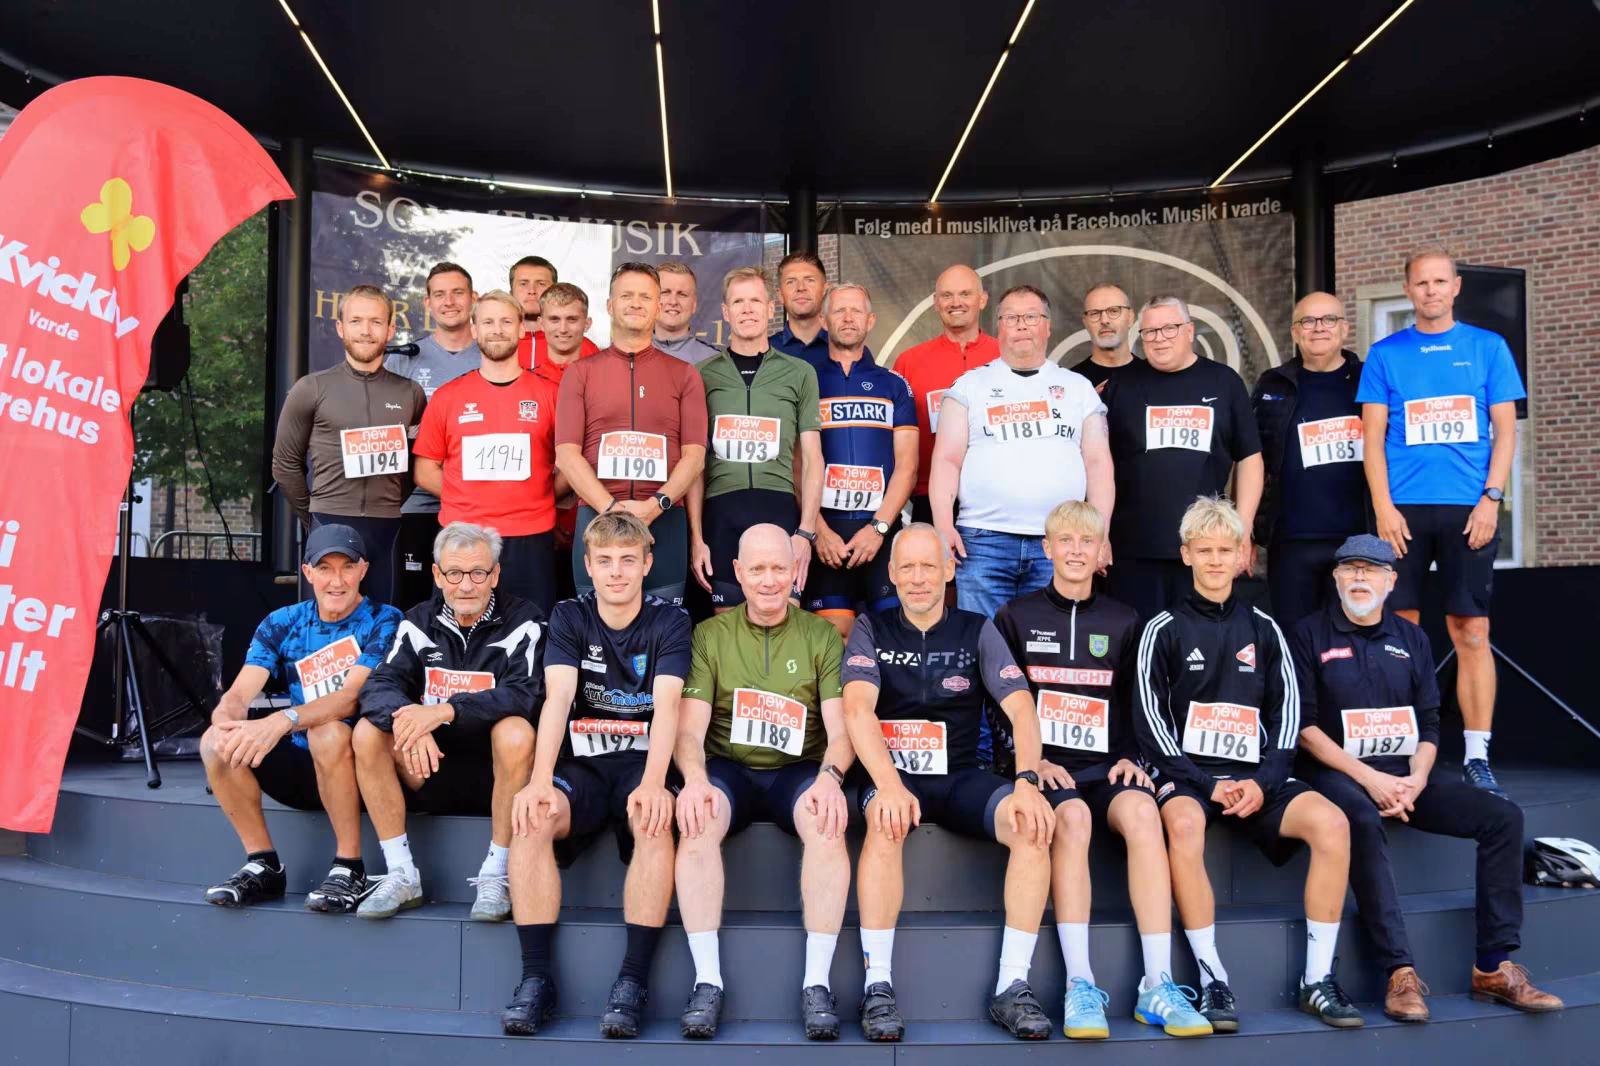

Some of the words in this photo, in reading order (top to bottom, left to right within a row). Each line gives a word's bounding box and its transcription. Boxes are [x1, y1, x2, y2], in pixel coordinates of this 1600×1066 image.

[855, 218, 892, 238] Følg
[896, 217, 932, 235] med
[937, 218, 942, 234] i
[947, 215, 1035, 234] musiklivet
[1041, 213, 1062, 233] på
[1067, 209, 1158, 231] Facebook:
[1163, 205, 1217, 224] Musik
[1222, 202, 1227, 218] i
[1231, 197, 1281, 218] varde
[28, 308, 80, 341] Varde
[11, 347, 120, 412] lokale
[833, 404, 886, 421] STARK
[1004, 402, 1031, 412] new
[1167, 408, 1194, 417] new
[1425, 399, 1454, 410] new
[734, 418, 760, 428] new
[991, 409, 1047, 425] balance
[1152, 416, 1207, 429] balance
[1412, 407, 1470, 424] balance
[720, 426, 774, 440] balance
[1001, 421, 1042, 441] 1181
[1319, 419, 1345, 430] new
[1420, 421, 1465, 441] 1199
[362, 429, 389, 441] new
[621, 434, 647, 445] new
[1160, 428, 1200, 448] 1198
[1305, 427, 1359, 444] balance
[348, 438, 402, 454] balance
[605, 444, 661, 458] balance
[726, 440, 768, 461] 1193
[1315, 440, 1355, 463] 1185
[358, 451, 399, 475] 1194
[475, 444, 524, 471] 1194
[612, 457, 656, 479] 1190
[843, 467, 869, 478] new
[830, 476, 880, 490] balance
[833, 489, 872, 509] 1191
[312, 648, 335, 668] new
[876, 648, 955, 667] CRAFT
[303, 653, 356, 685] balance
[443, 673, 472, 686] new
[757, 693, 786, 710] new
[1061, 696, 1089, 710] new
[740, 702, 799, 728] balance
[1044, 704, 1100, 726] balance
[1211, 706, 1240, 719] new
[1365, 711, 1392, 723] new
[577, 719, 640, 735] balance
[893, 723, 922, 734] new
[1194, 716, 1255, 735] balance
[1351, 722, 1410, 737] balance
[746, 719, 791, 750] 1189
[1051, 721, 1096, 748] 1196
[587, 733, 636, 754] 1192
[1199, 730, 1248, 758] 1196
[1359, 736, 1405, 757] 1187
